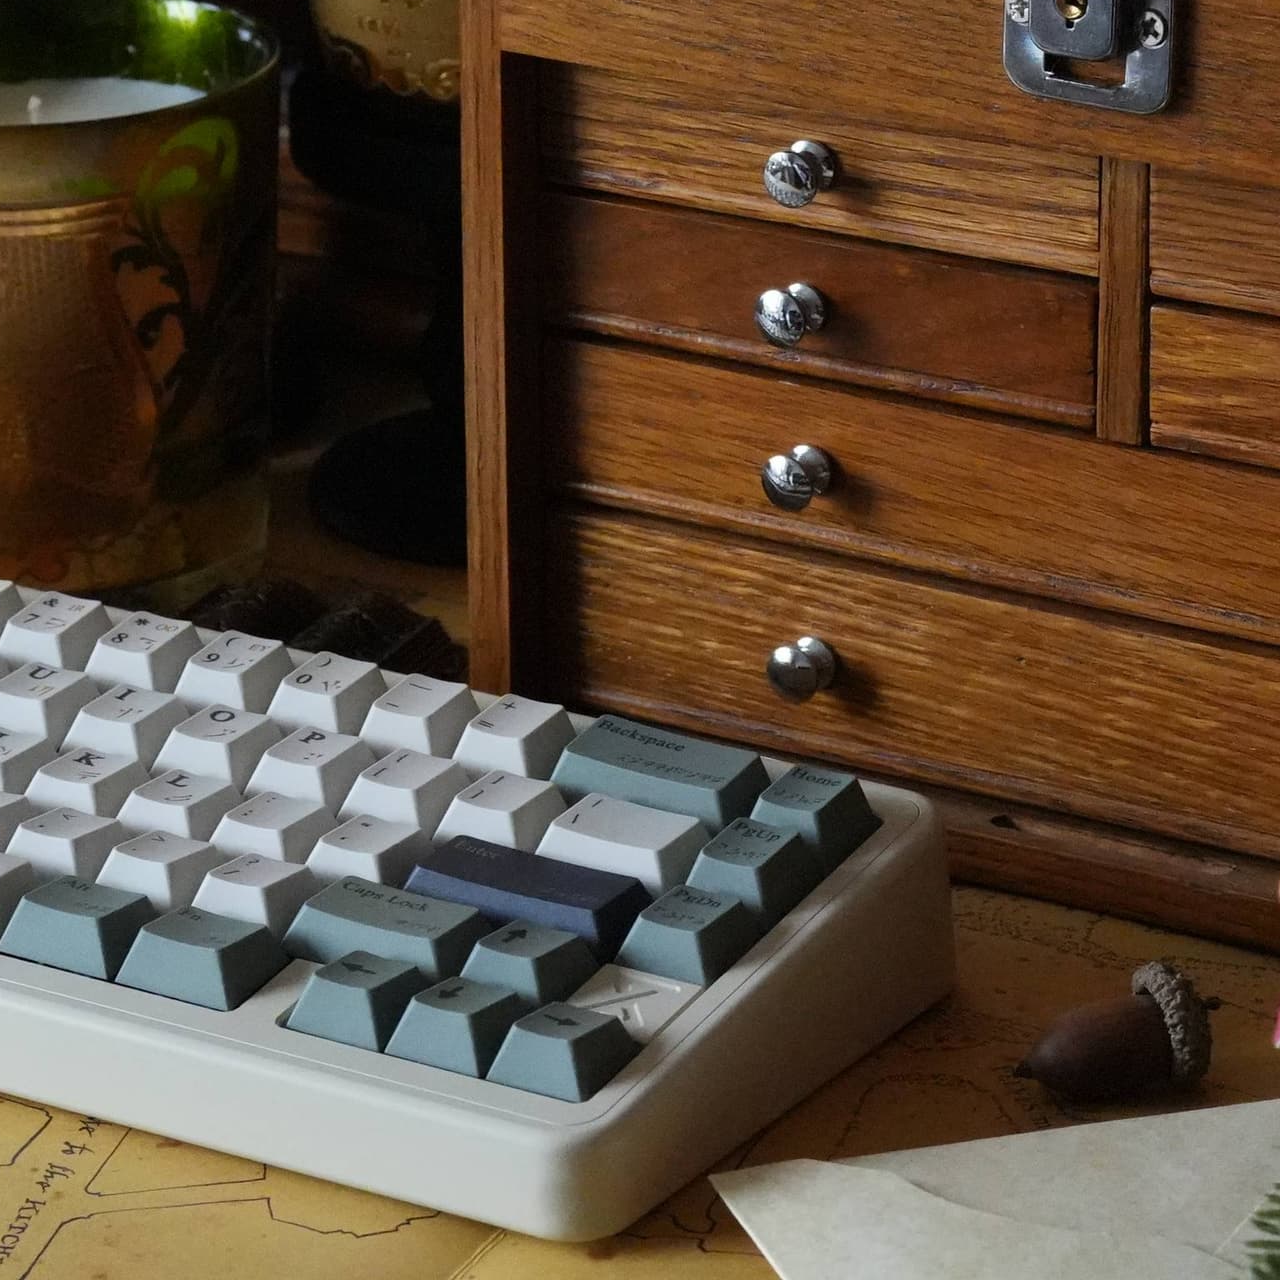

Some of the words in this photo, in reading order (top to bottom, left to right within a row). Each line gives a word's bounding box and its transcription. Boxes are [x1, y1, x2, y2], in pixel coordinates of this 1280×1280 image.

[597, 718, 686, 753] Backspace
[791, 766, 842, 787] Home
[733, 822, 781, 841] PgUp
[343, 881, 384, 899] Caps
[388, 895, 429, 912] Lock
